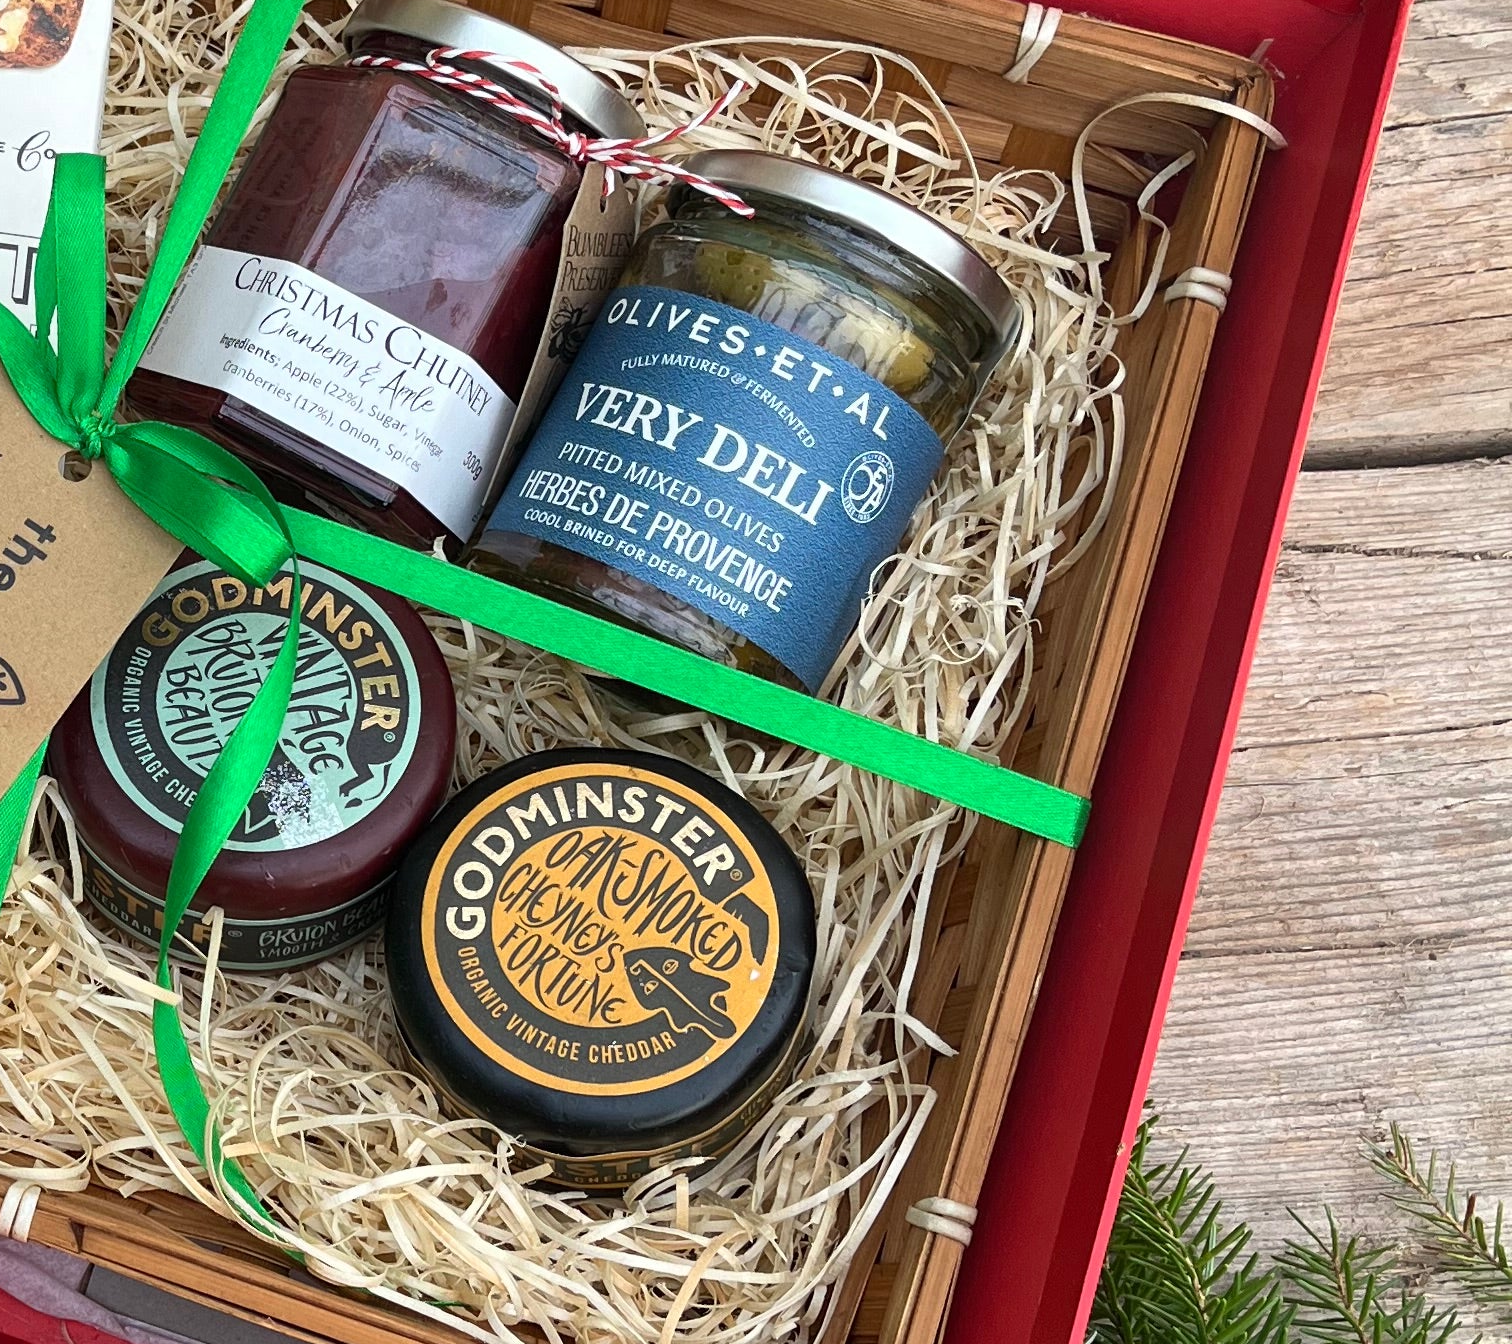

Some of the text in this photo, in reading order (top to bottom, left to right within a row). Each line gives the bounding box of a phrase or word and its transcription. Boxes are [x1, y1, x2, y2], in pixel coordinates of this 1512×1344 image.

[222, 359, 292, 403] Cranberries
[338, 418, 381, 452] Onion,
[384, 442, 422, 474] Spices
[258, 307, 361, 378] Cranberry
[378, 369, 437, 413] Apple
[282, 360, 323, 389] Apple
[367, 404, 408, 437] Sugar,
[619, 353, 660, 372] FULLY
[660, 352, 729, 380] MATURED
[743, 378, 817, 450] FERMENTED
[462, 450, 484, 482] 300g
[557, 441, 622, 478] PITTED
[624, 460, 703, 508] MIXED
[704, 498, 786, 554] OLIVES
[574, 382, 836, 527] VERY DELI
[518, 469, 793, 614] HERBES DE PROVENCE
[523, 507, 751, 618] COOOL BRINED FOR DEEP FLAVOUR
[141, 576, 400, 732] GODMINSTER
[186, 619, 264, 736] BRUTO
[121, 646, 171, 783] ORGANIC VINTAGE
[445, 781, 737, 942] GODMINSTER
[457, 946, 677, 1064] ORGANIC VINTAGE CHEDDAR
[496, 926, 627, 1025] FORTUNE
